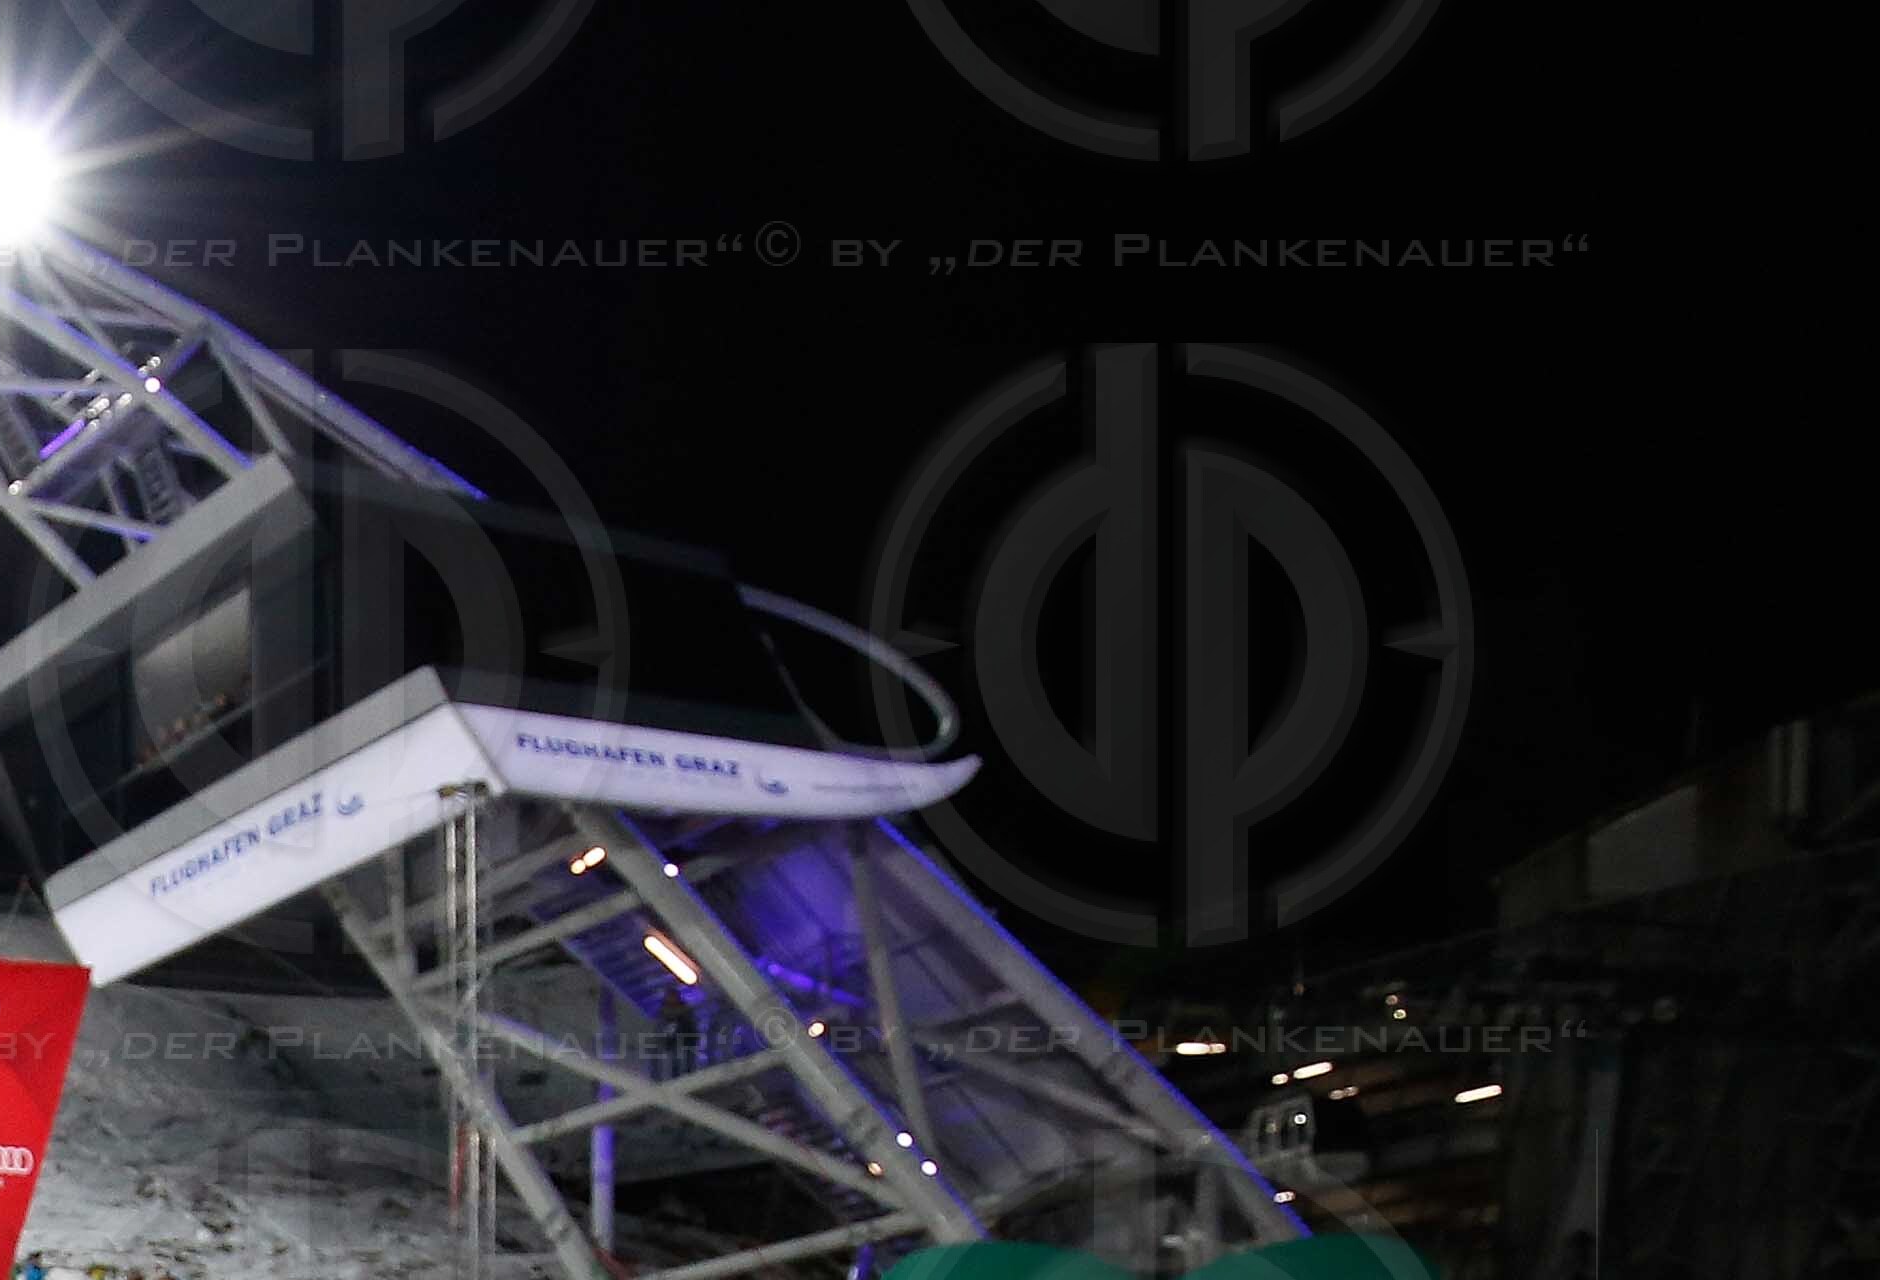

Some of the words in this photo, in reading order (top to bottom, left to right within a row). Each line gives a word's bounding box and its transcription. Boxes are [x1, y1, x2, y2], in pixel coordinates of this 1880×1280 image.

[516, 732, 667, 770] FLUGHAFEN
[674, 753, 741, 780] GRAZ
[149, 824, 262, 899] FLUGHAFEN
[267, 792, 323, 839] GRAZ
